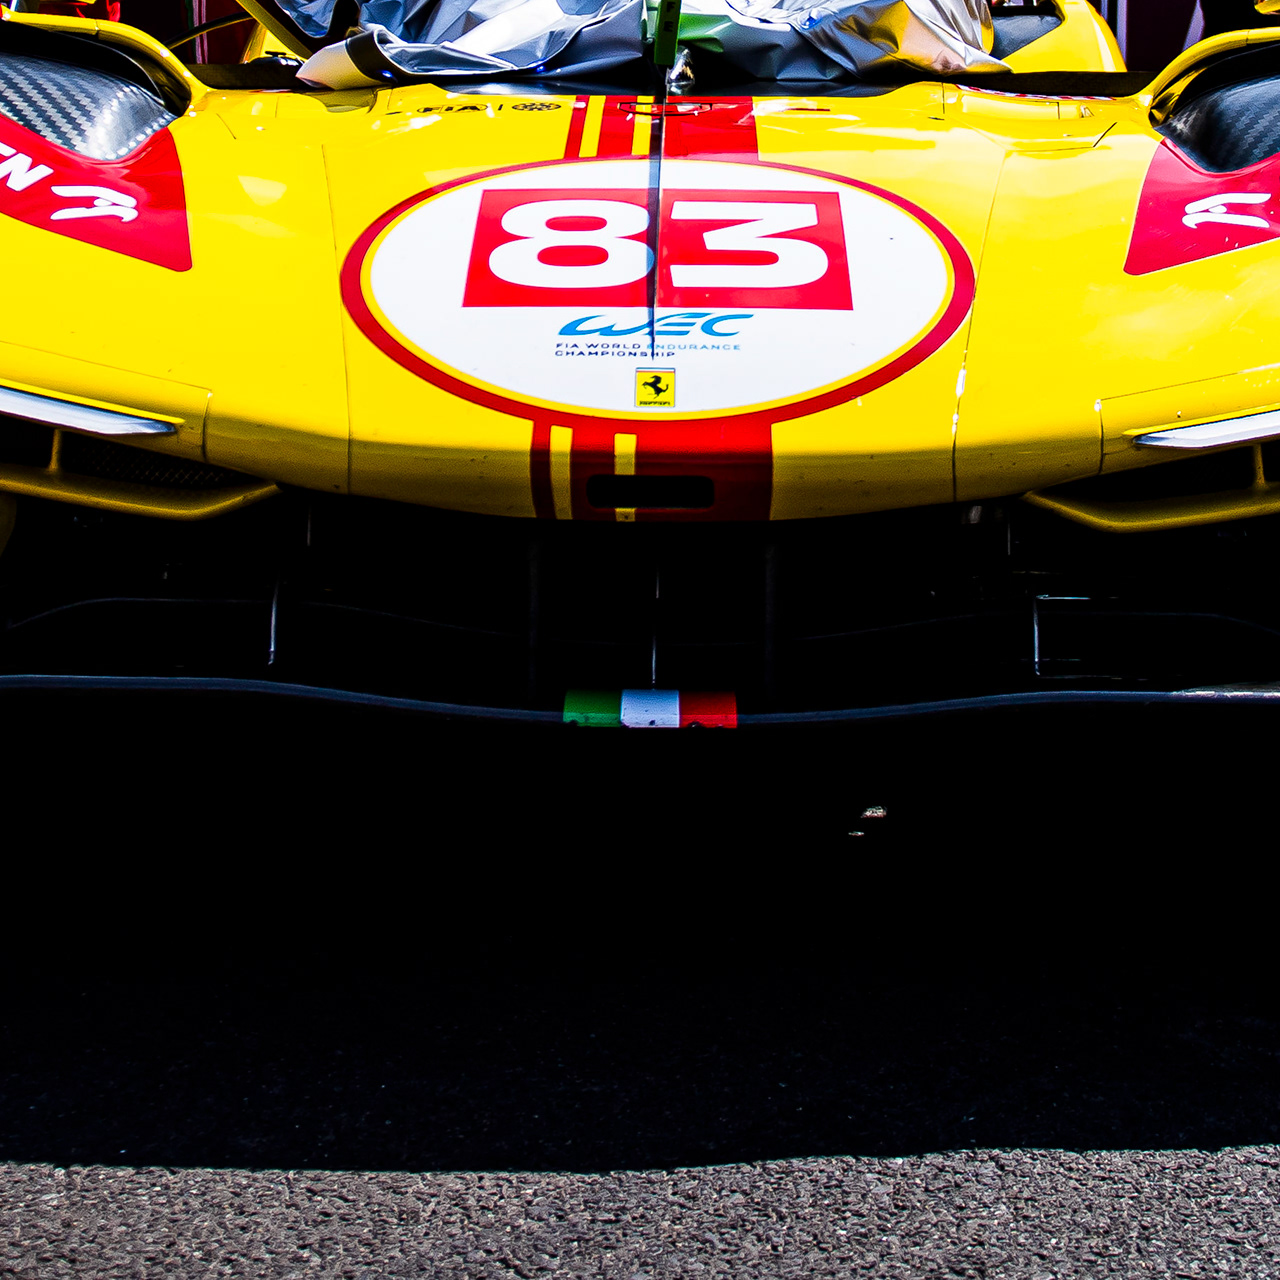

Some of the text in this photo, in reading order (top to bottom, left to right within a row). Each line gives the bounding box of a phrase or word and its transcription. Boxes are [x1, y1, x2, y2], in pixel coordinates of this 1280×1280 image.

[488, 199, 829, 289] 83
[558, 312, 755, 337] WEC
[555, 342, 742, 351] FIA WORLD ENDURANCE
[555, 350, 676, 358] CHAMPIONSHIP
